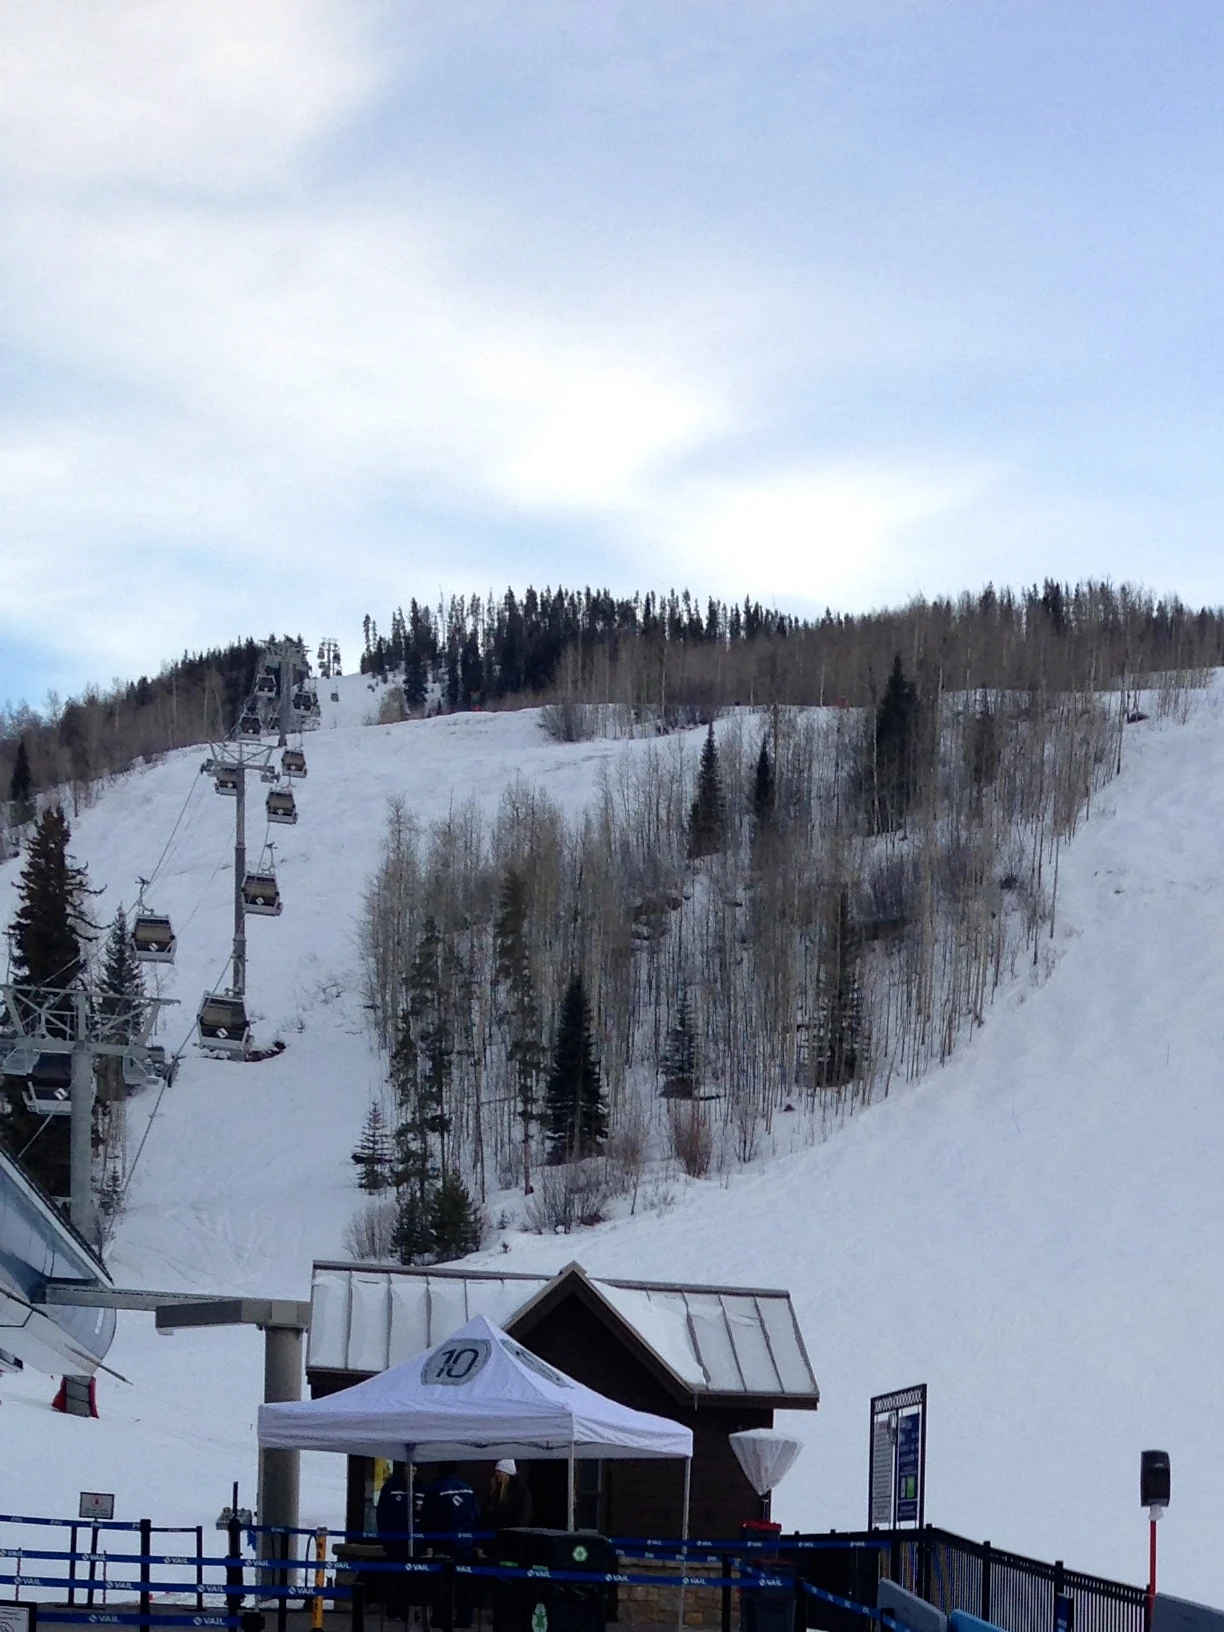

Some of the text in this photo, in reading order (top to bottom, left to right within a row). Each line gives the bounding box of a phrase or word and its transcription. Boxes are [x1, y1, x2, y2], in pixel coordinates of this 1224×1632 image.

[435, 1348, 479, 1379] 10
[22, 1578, 43, 1586] VAIL
[114, 1582, 134, 1590] VAIL
[205, 1585, 226, 1593] VAIL
[297, 1587, 316, 1595] VAIL
[99, 1615, 121, 1623] VAIL
[203, 1616, 226, 1625] VAIL
